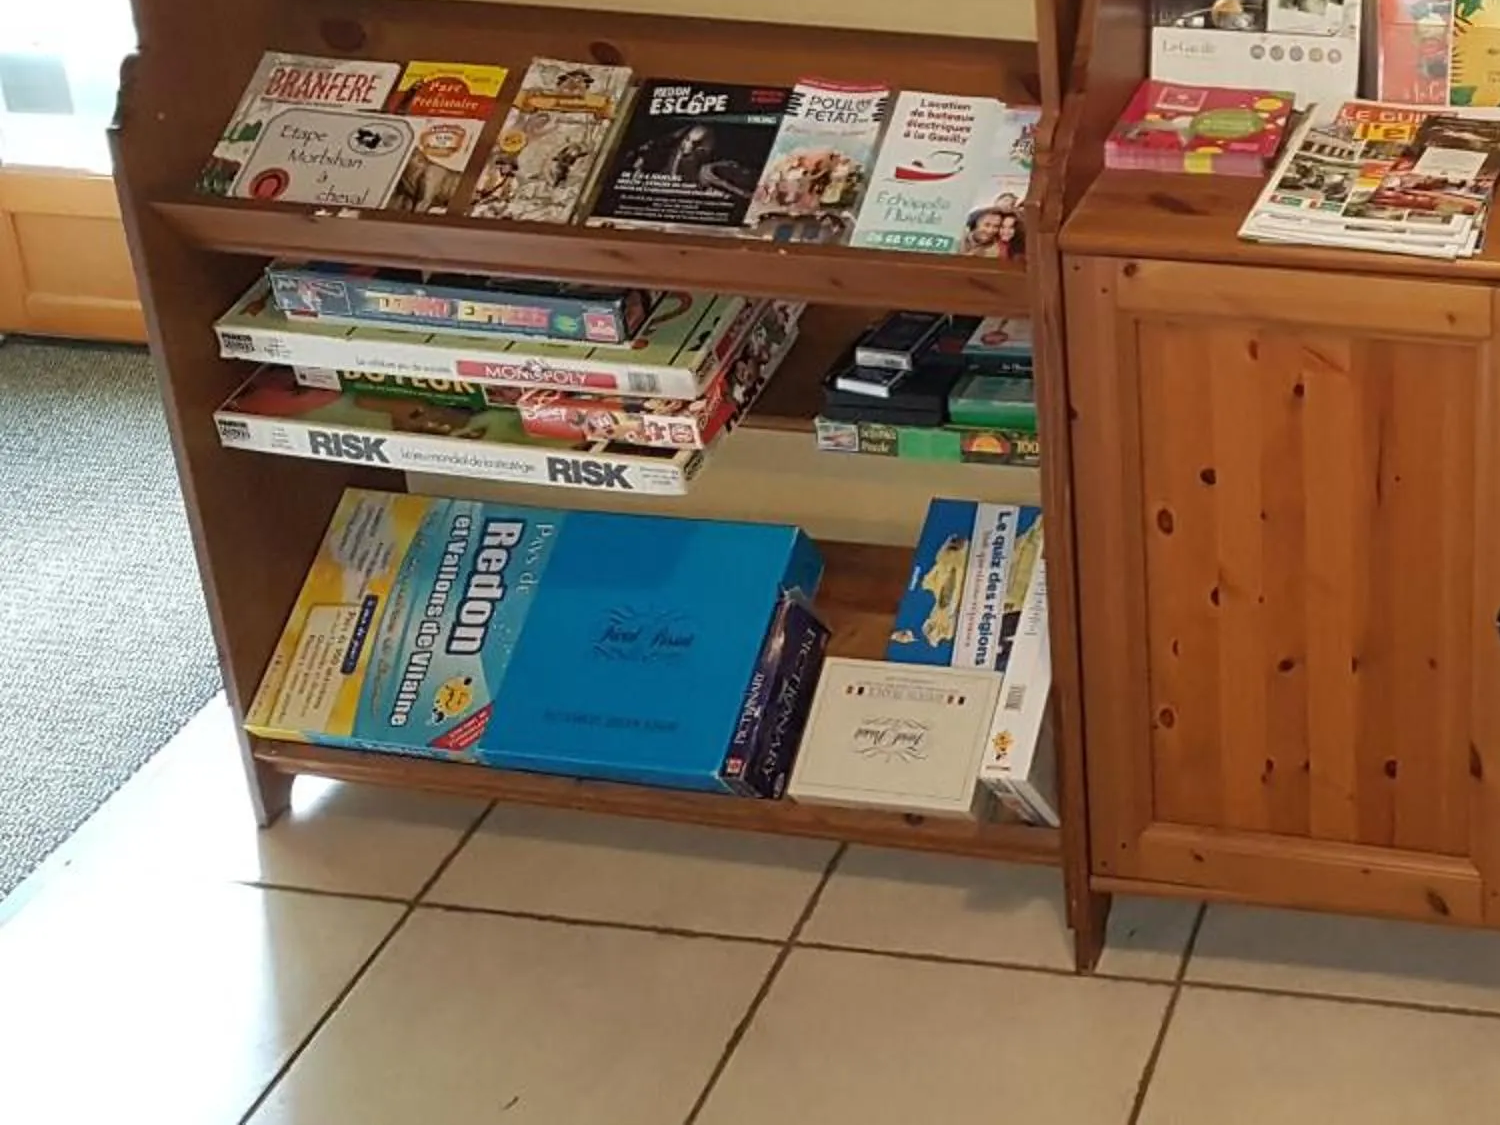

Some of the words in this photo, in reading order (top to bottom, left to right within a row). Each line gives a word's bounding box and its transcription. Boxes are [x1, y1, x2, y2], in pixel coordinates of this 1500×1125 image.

[919, 97, 972, 111] Location
[316, 184, 370, 205] cheval
[484, 364, 588, 385] MONOPOLY
[307, 430, 390, 464] RISK
[546, 455, 634, 490] RISK
[453, 515, 472, 535] et
[997, 510, 1013, 533] Le
[988, 534, 1007, 569] quiz
[425, 539, 468, 618] Vallons
[448, 518, 525, 655] Redon
[985, 571, 1001, 602] des
[417, 619, 440, 647] de
[973, 604, 999, 666] régions
[389, 651, 433, 727] Vilaine
[761, 626, 817, 781] PICTIONARY
